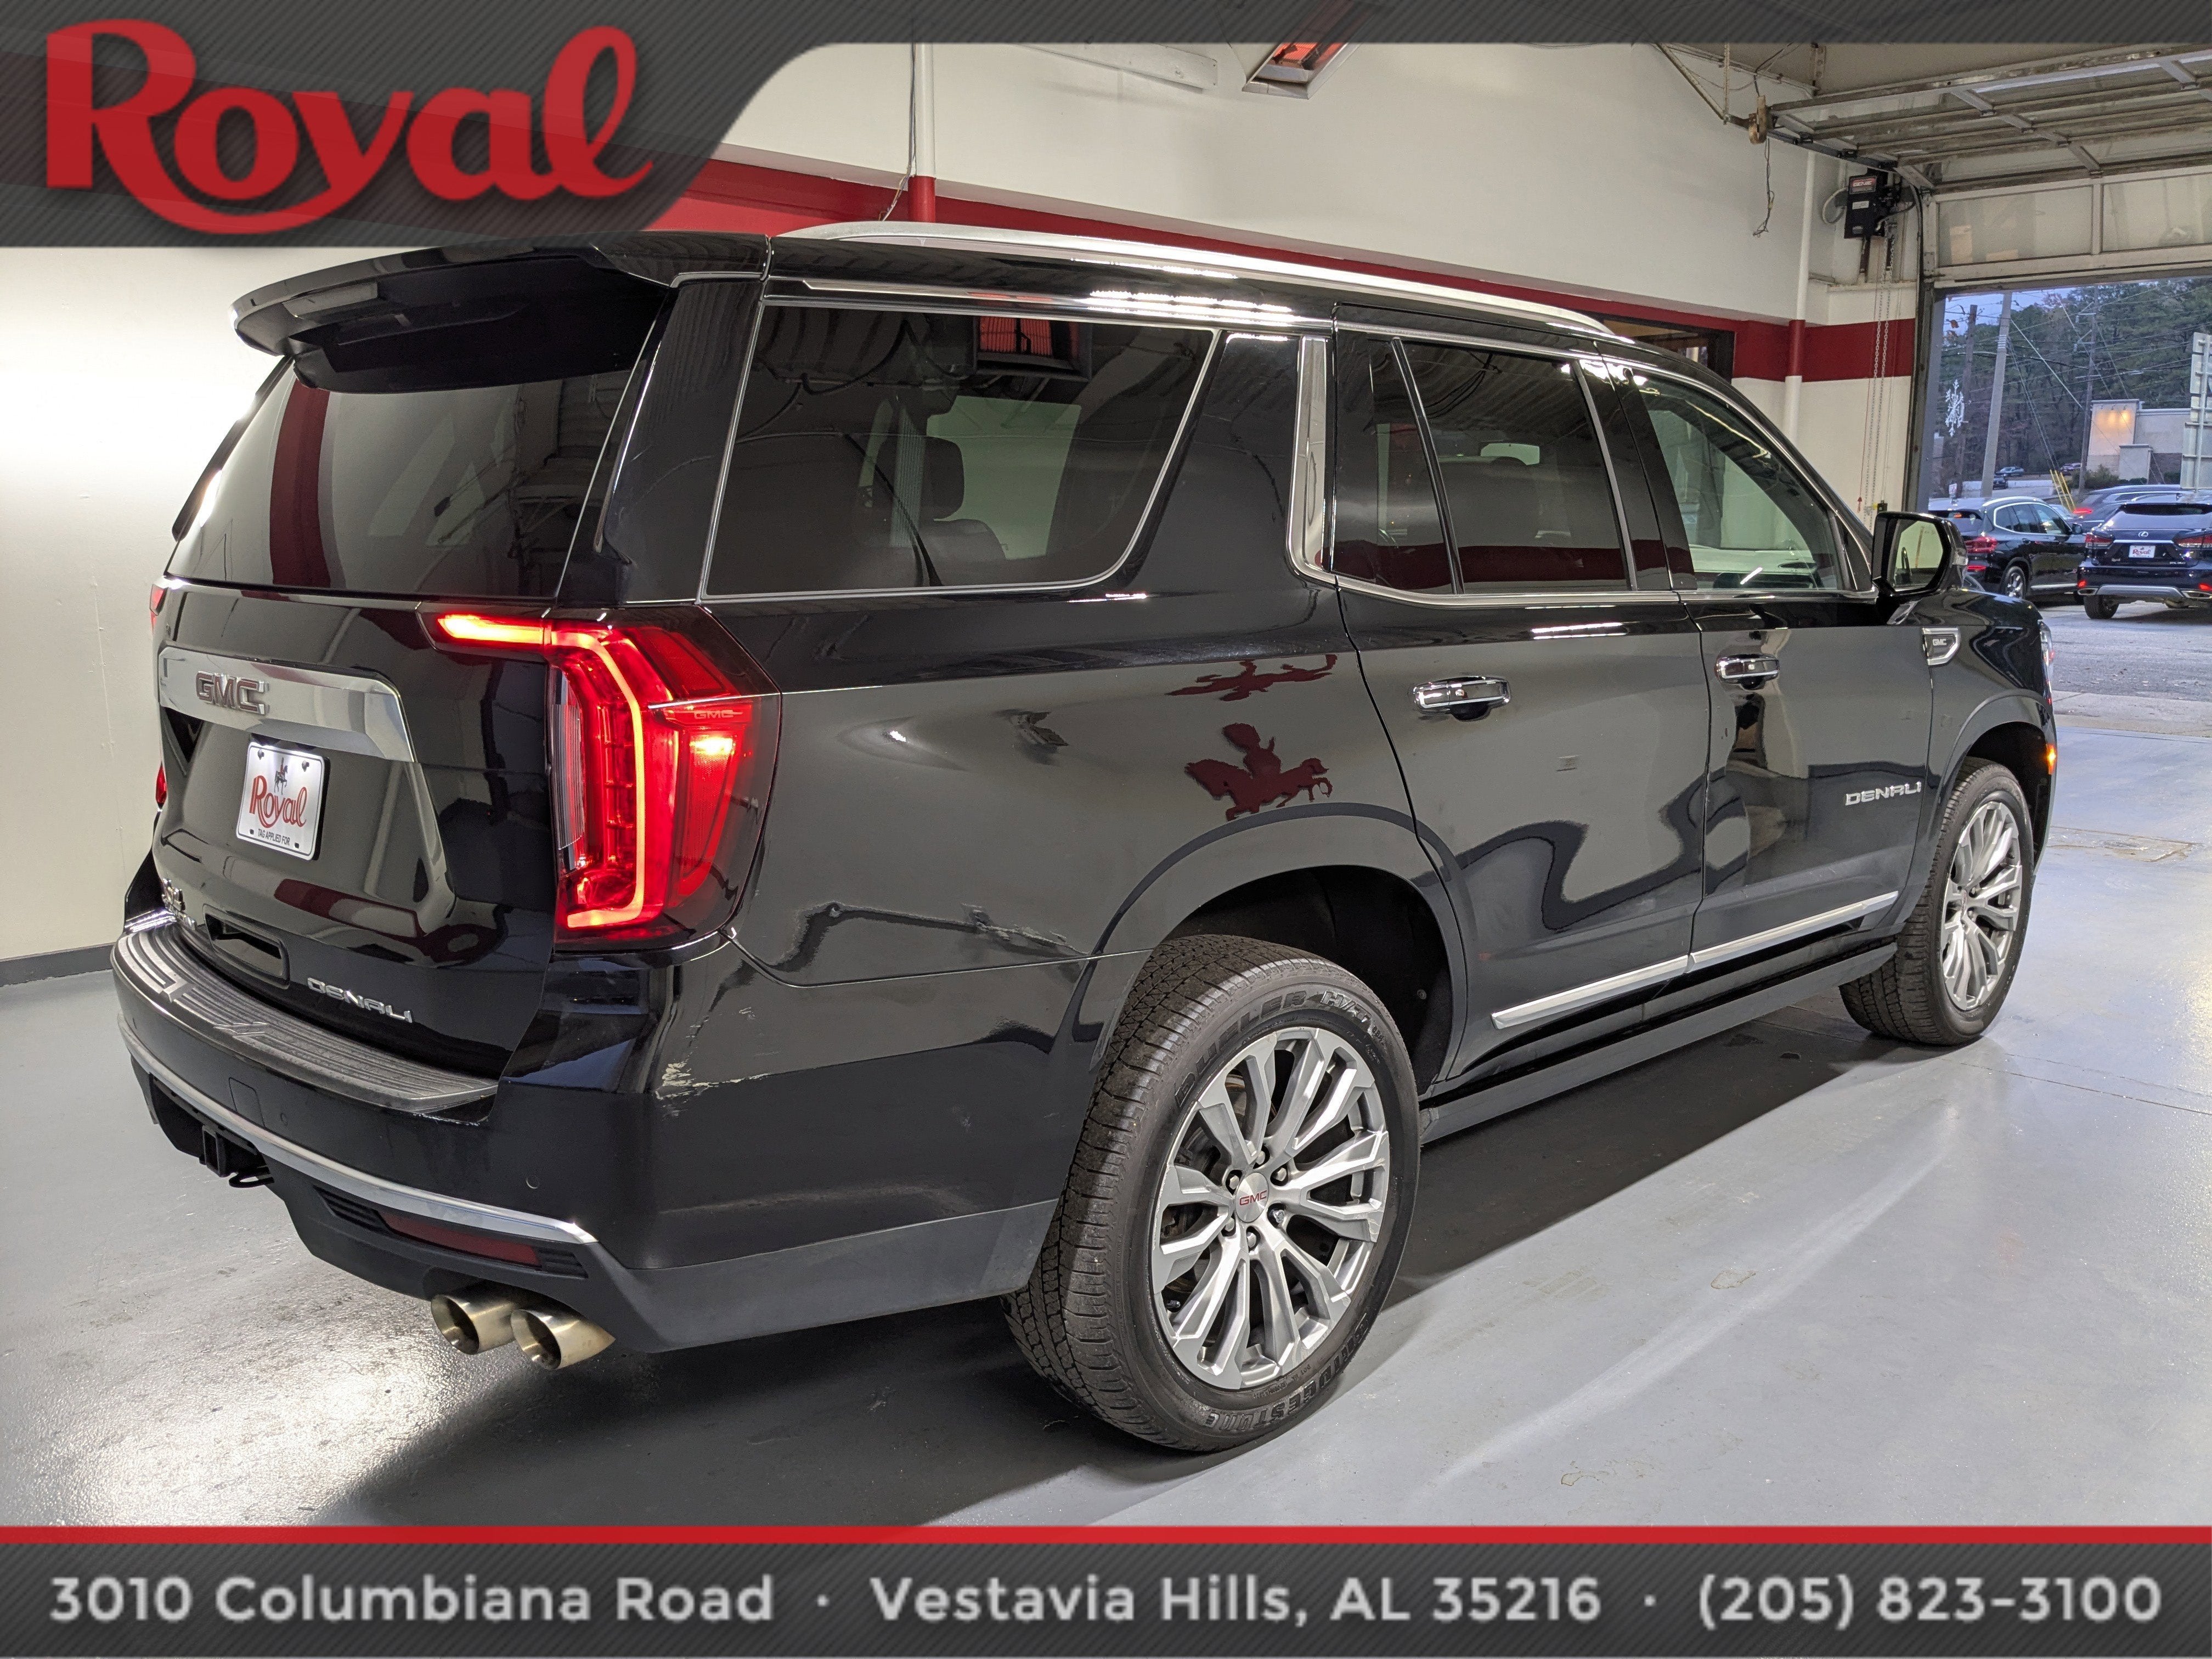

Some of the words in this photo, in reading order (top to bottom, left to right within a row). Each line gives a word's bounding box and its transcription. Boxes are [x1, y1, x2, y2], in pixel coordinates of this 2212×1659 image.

[1932, 638, 1947, 646] GMC
[196, 670, 267, 715] GMC
[693, 709, 734, 719] GMC
[249, 775, 308, 828] Royal
[1844, 781, 1922, 806] DENALI
[257, 828, 266, 839] TAG
[265, 832, 282, 843] APPLIED
[281, 836, 291, 846] FOR
[307, 977, 413, 1023] DENALI
[1174, 990, 1307, 1108] DUELER
[1239, 1189, 1267, 1205] GMC
